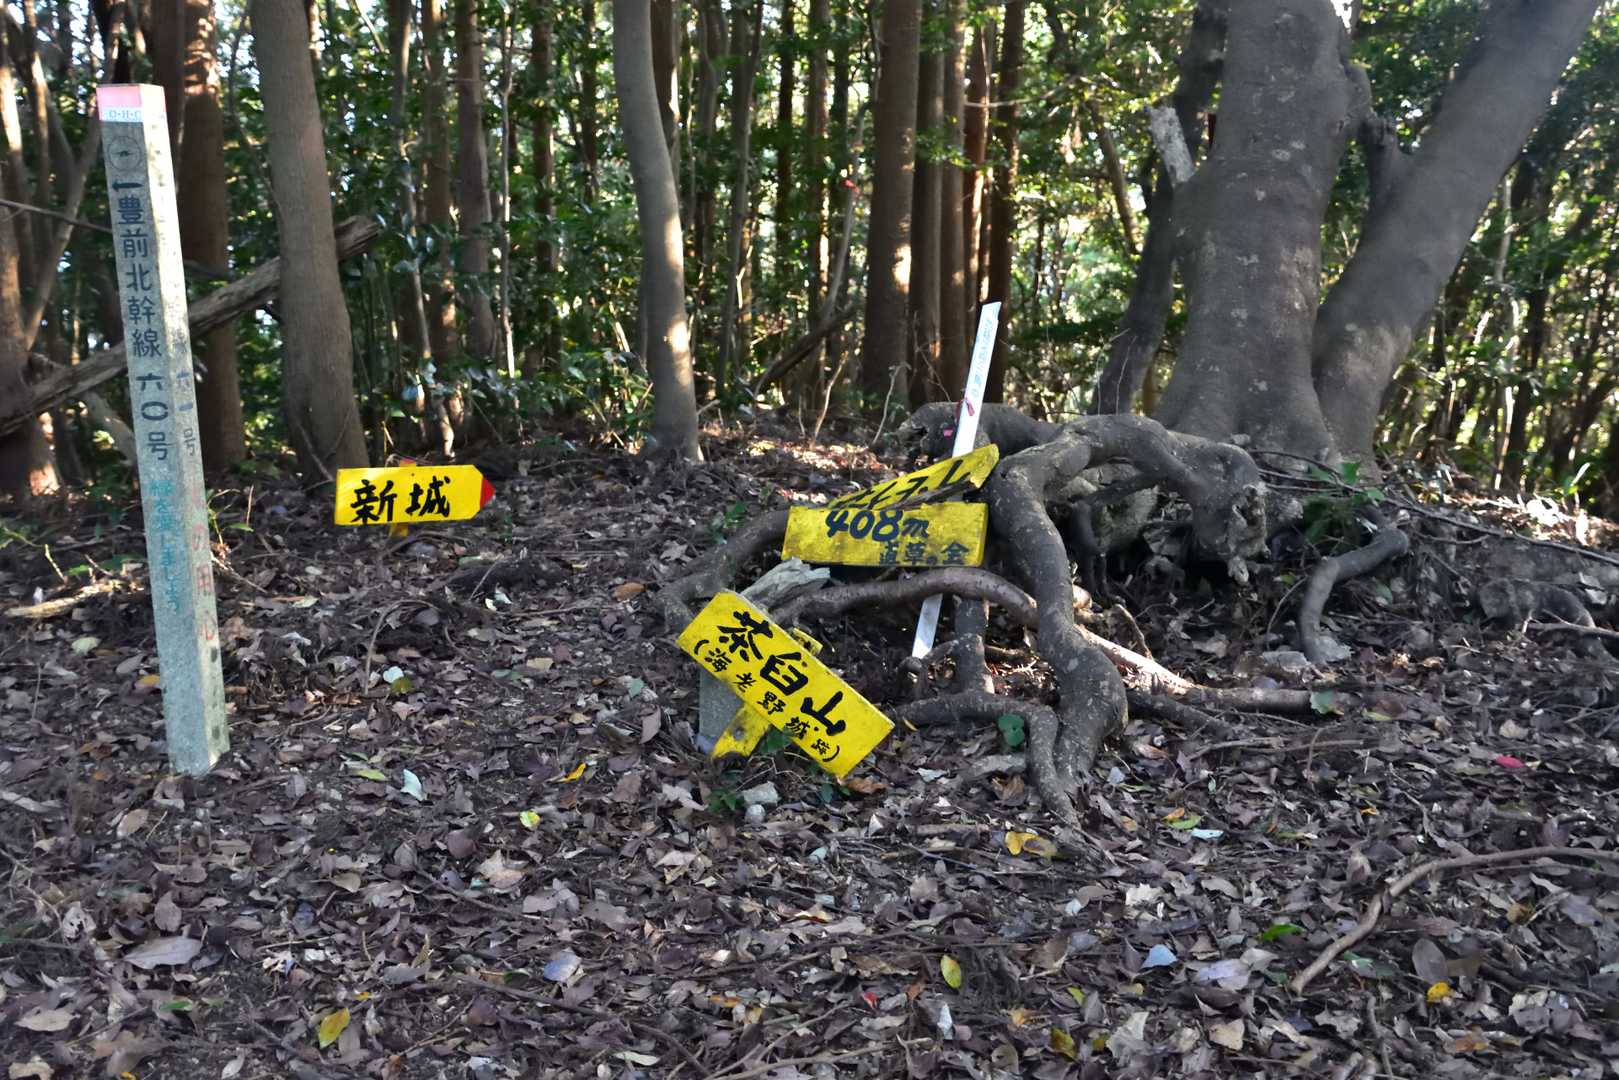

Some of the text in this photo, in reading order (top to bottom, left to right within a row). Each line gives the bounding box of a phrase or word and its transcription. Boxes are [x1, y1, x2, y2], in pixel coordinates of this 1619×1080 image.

[350, 475, 451, 523] 新城
[716, 611, 846, 737] 茶臼山
